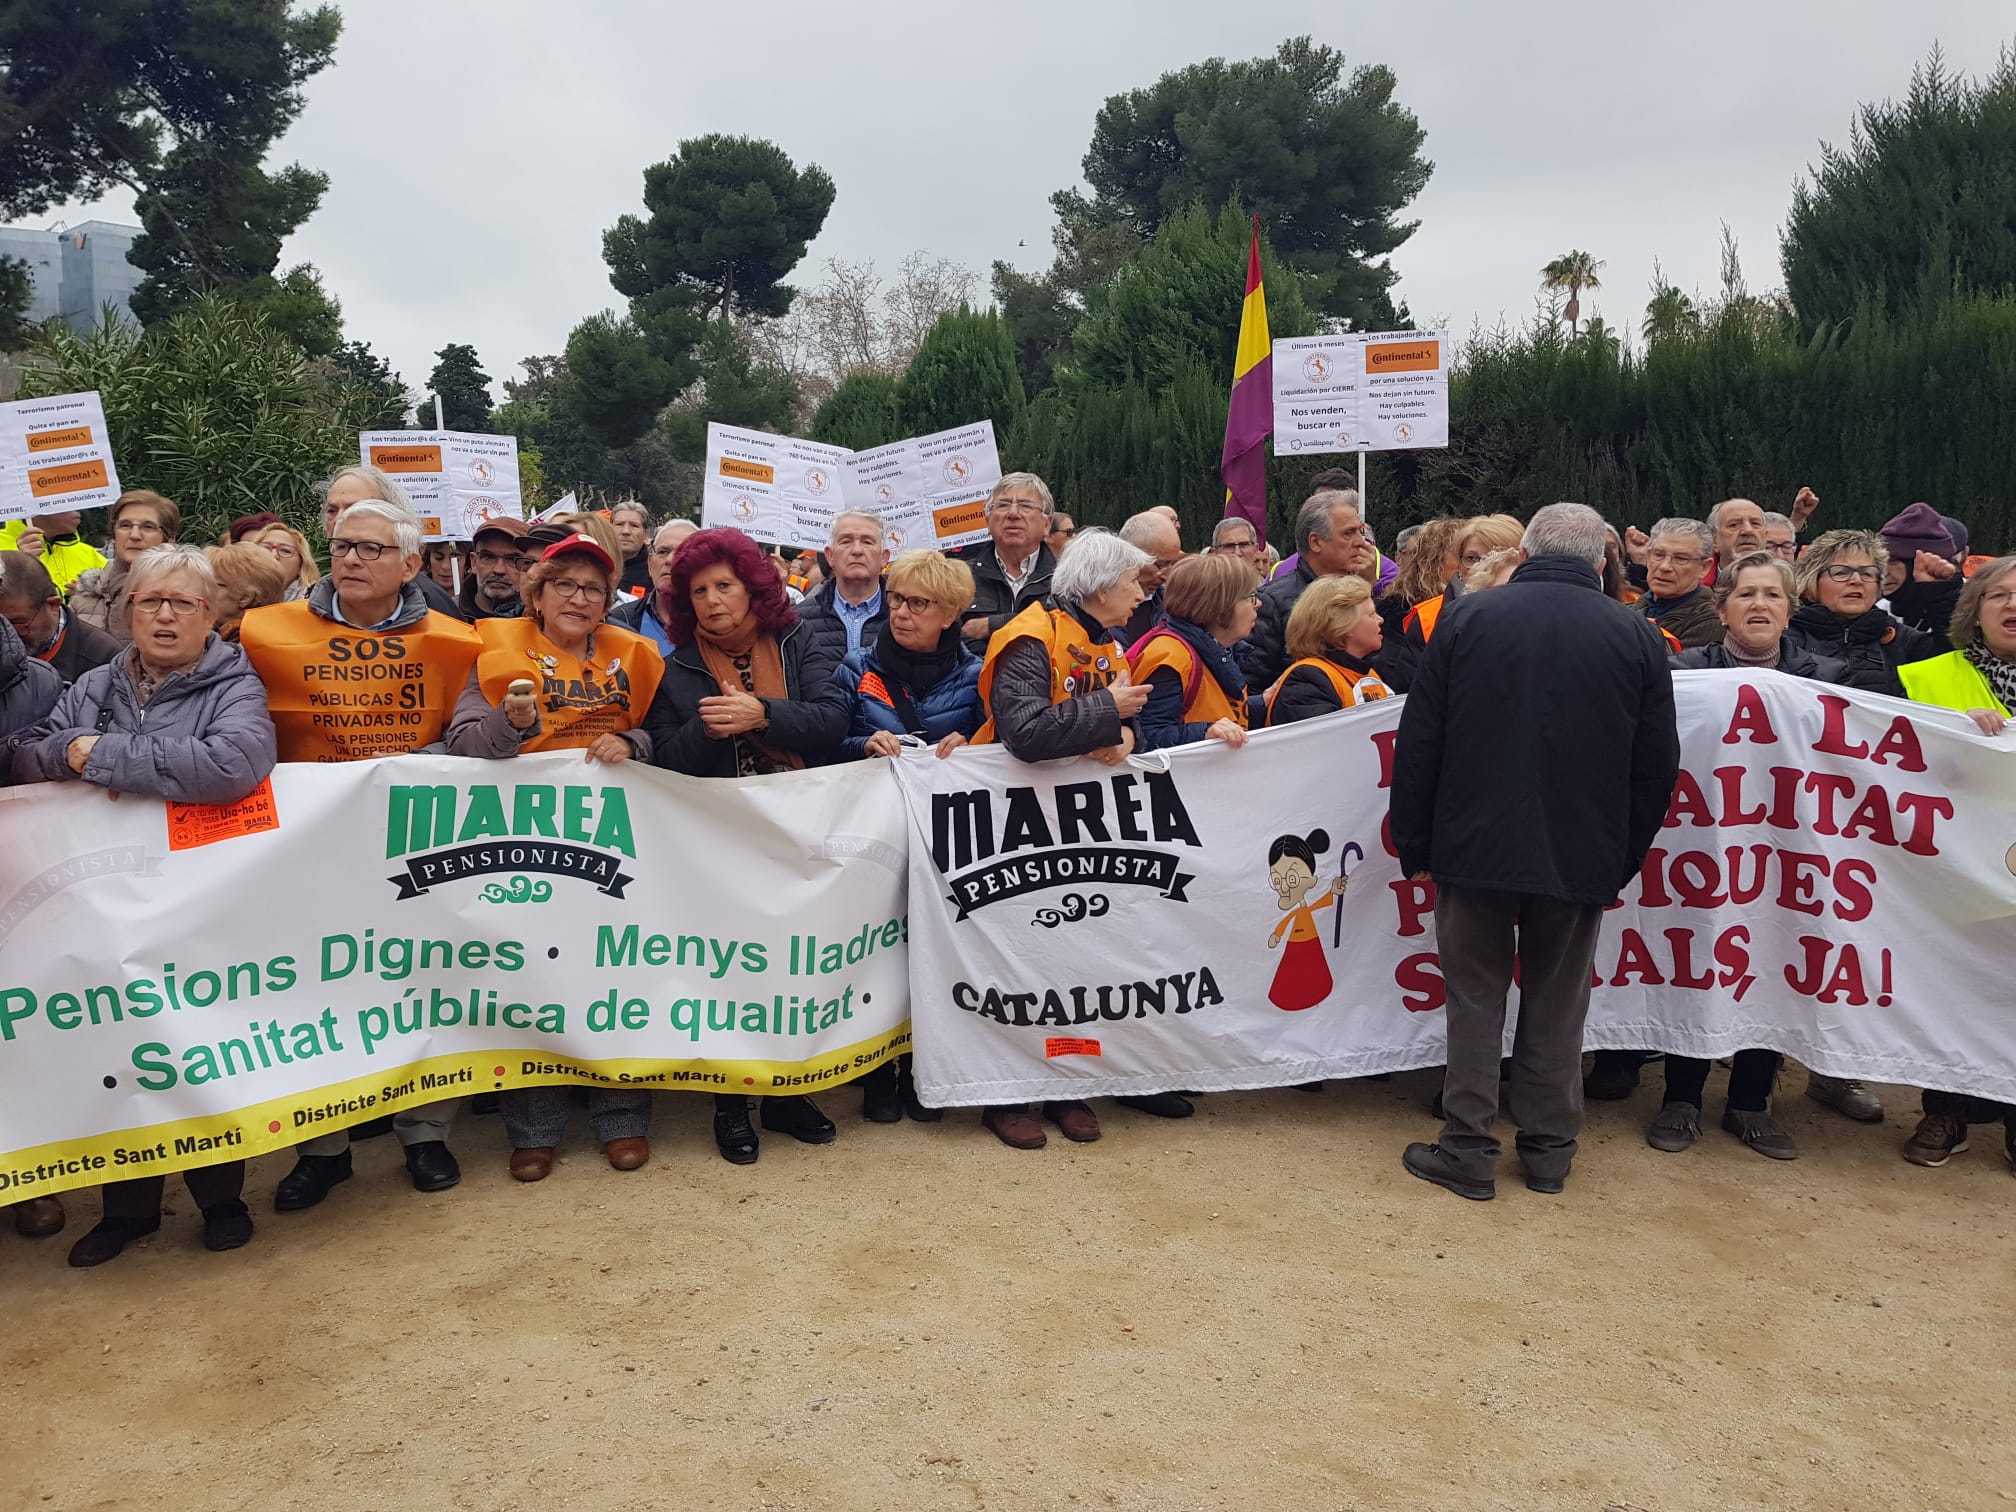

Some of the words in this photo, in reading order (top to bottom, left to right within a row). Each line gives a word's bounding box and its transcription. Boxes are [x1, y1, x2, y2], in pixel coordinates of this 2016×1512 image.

[1380, 332, 1426, 341] trabajador@s
[1291, 342, 1318, 350] Últimos
[1371, 350, 1424, 365] Continental
[1369, 378, 1381, 386] por
[1396, 375, 1425, 383] solución
[1280, 386, 1318, 396] Liquidación
[1332, 384, 1357, 392] CIERRE.
[1383, 390, 1402, 399] dejan
[1414, 388, 1437, 396] futuro.
[17, 406, 55, 416] Terrorismo
[56, 402, 85, 412] patronal
[1291, 408, 1309, 417] Nos
[1310, 406, 1347, 416] venden,
[1394, 400, 1427, 409] culpables.
[1392, 412, 1429, 420] soluciones.
[28, 423, 48, 431] Quita
[56, 421, 66, 429] pan
[1297, 421, 1328, 430] buscar
[1329, 421, 1341, 429] en
[30, 432, 79, 448] Continental
[470, 439, 484, 448] puto
[485, 440, 506, 448] alemán
[719, 432, 751, 443] Terrorismo
[751, 438, 776, 448] patronal
[918, 440, 933, 450] Vino
[942, 434, 958, 444] puto
[958, 429, 980, 440] alemán
[474, 448, 488, 456] dejar
[724, 450, 741, 458] Quita
[922, 452, 934, 460] nos
[947, 444, 963, 454] dejar
[963, 441, 973, 449] sin
[974, 438, 986, 449] pan
[42, 452, 89, 464] trabajador@s
[376, 454, 428, 464] Continental
[858, 453, 876, 464] dejan
[876, 450, 886, 459] sin
[722, 462, 764, 477] Continental
[858, 467, 870, 476] Hay
[870, 460, 900, 472] culpables.
[37, 470, 91, 488] Continental
[402, 476, 429, 484] solución
[858, 478, 871, 486] Hay
[871, 470, 904, 483] soluciones.
[722, 480, 746, 491] Últimos
[750, 487, 769, 495] meses
[67, 492, 96, 503] solución
[944, 490, 985, 505] trabajador@s
[792, 504, 807, 512] Nos
[903, 510, 920, 520] lucha
[797, 516, 820, 528] buscar
[755, 528, 777, 538] CIERRE.
[941, 540, 954, 549] por
[328, 636, 407, 662] SOS
[303, 662, 424, 682] PENSIONES
[308, 689, 393, 707] PÚBLICAS
[399, 682, 426, 710] SI
[312, 713, 394, 728] PRIVADAS
[399, 712, 422, 726] NO
[1722, 684, 1778, 744] A
[1812, 694, 1927, 773] LA
[350, 731, 418, 745] PENSIONES
[335, 745, 350, 756] UN
[220, 804, 254, 820] Usa-ho
[256, 799, 268, 810] bé
[386, 784, 637, 860] MAREA
[932, 770, 1203, 874] MAREA
[421, 848, 610, 880] PENSIONISTA
[964, 856, 1161, 903] PENSIONISTA
[1784, 935, 1893, 1008] JA!
[0, 952, 298, 1042] Pensions
[320, 928, 526, 982] Dignes
[595, 924, 768, 980] Menys
[952, 966, 1224, 1026] CATALUNYA
[130, 1007, 343, 1091] Sanitat
[358, 986, 566, 1055] pública
[586, 988, 650, 1032] de
[669, 983, 854, 1041] qualitat
[772, 1063, 850, 1088] Districte
[854, 1047, 886, 1069] Sant
[888, 1033, 913, 1051] Mar
[522, 1061, 610, 1083] Districte
[618, 1072, 666, 1084] Sant
[673, 1070, 726, 1084] Martí
[292, 1092, 376, 1128] Districte
[381, 1078, 415, 1102] Sant
[420, 1067, 473, 1092] Martí
[0, 1154, 106, 1191] Districte
[112, 1138, 166, 1166] Sant
[174, 1126, 243, 1157] Martí
